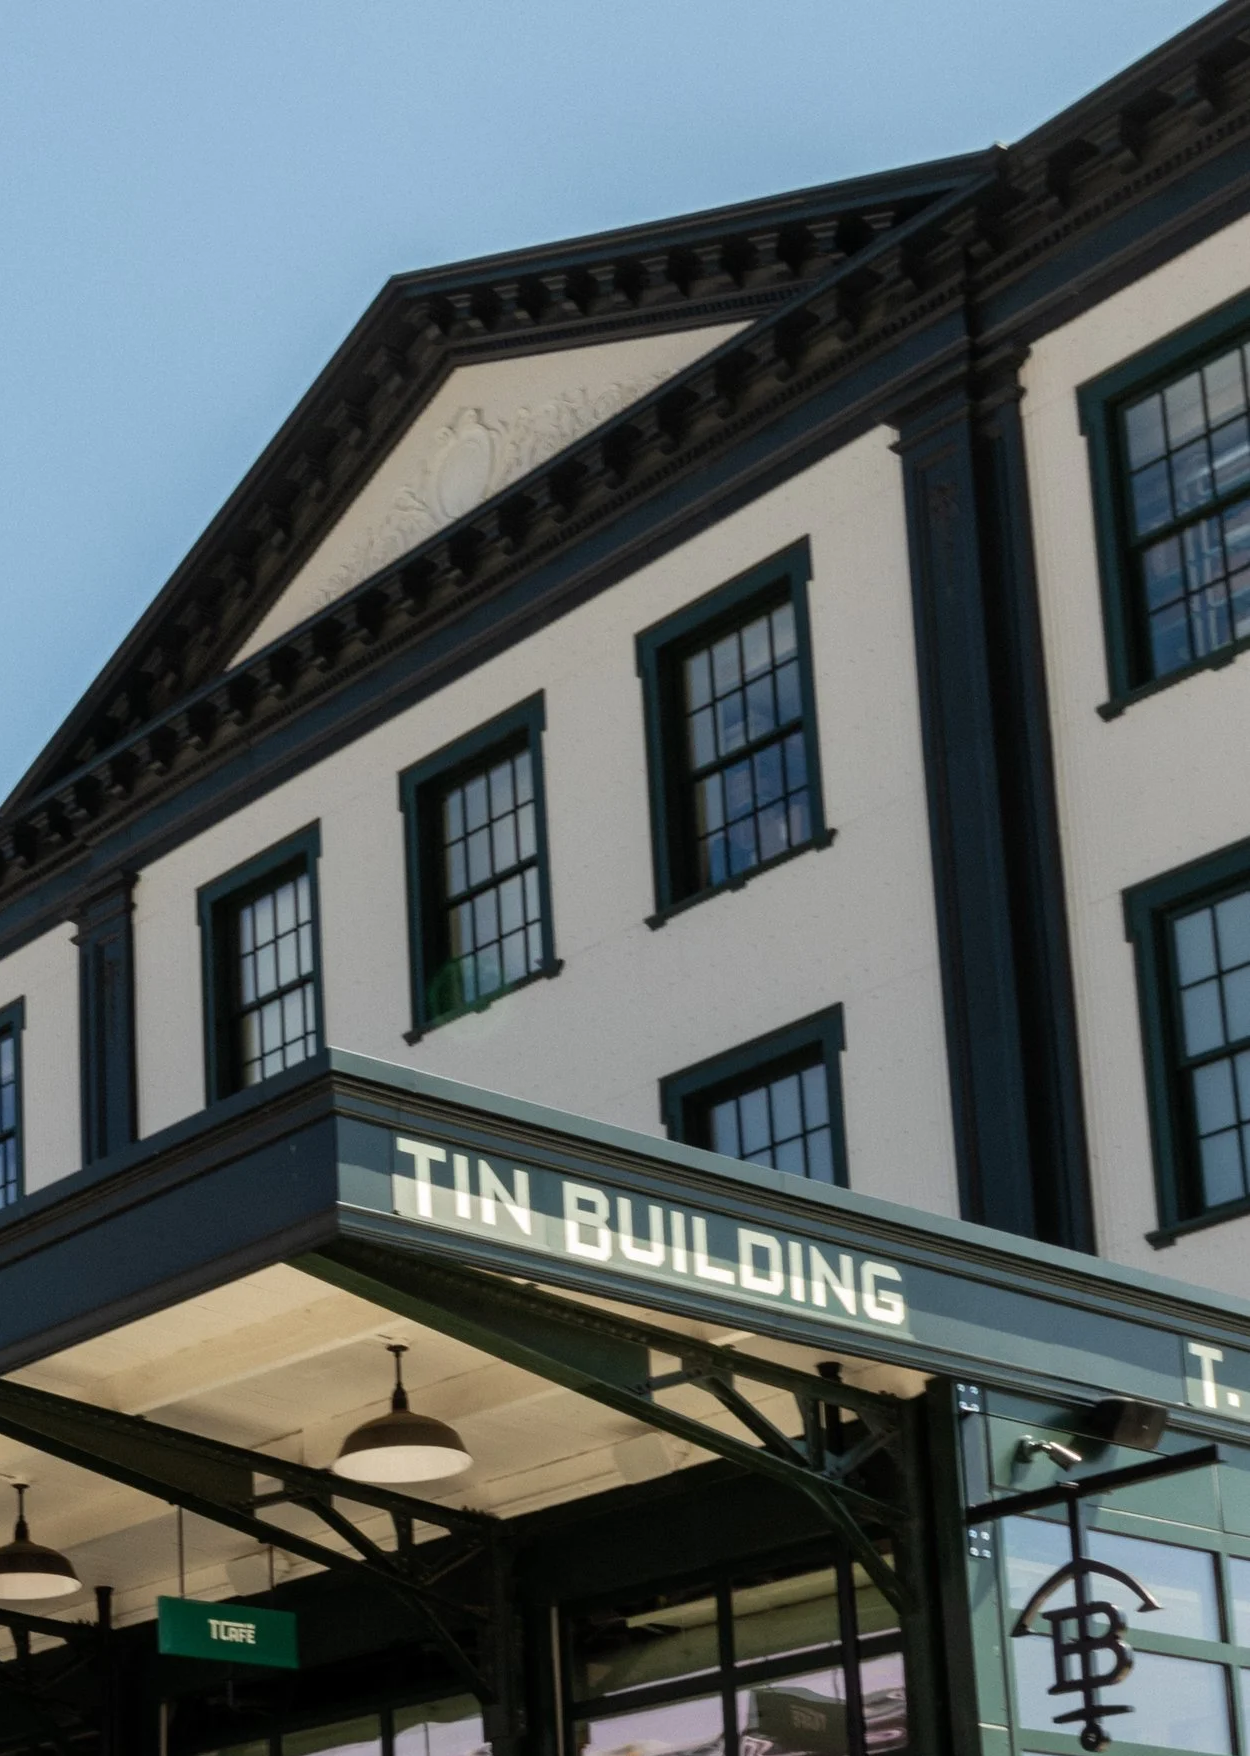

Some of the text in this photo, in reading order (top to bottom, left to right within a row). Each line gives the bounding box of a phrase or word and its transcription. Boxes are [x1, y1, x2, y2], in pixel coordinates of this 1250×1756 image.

[395, 1136, 905, 1326] TIN BUILDING
[1187, 1342, 1240, 1409] T.
